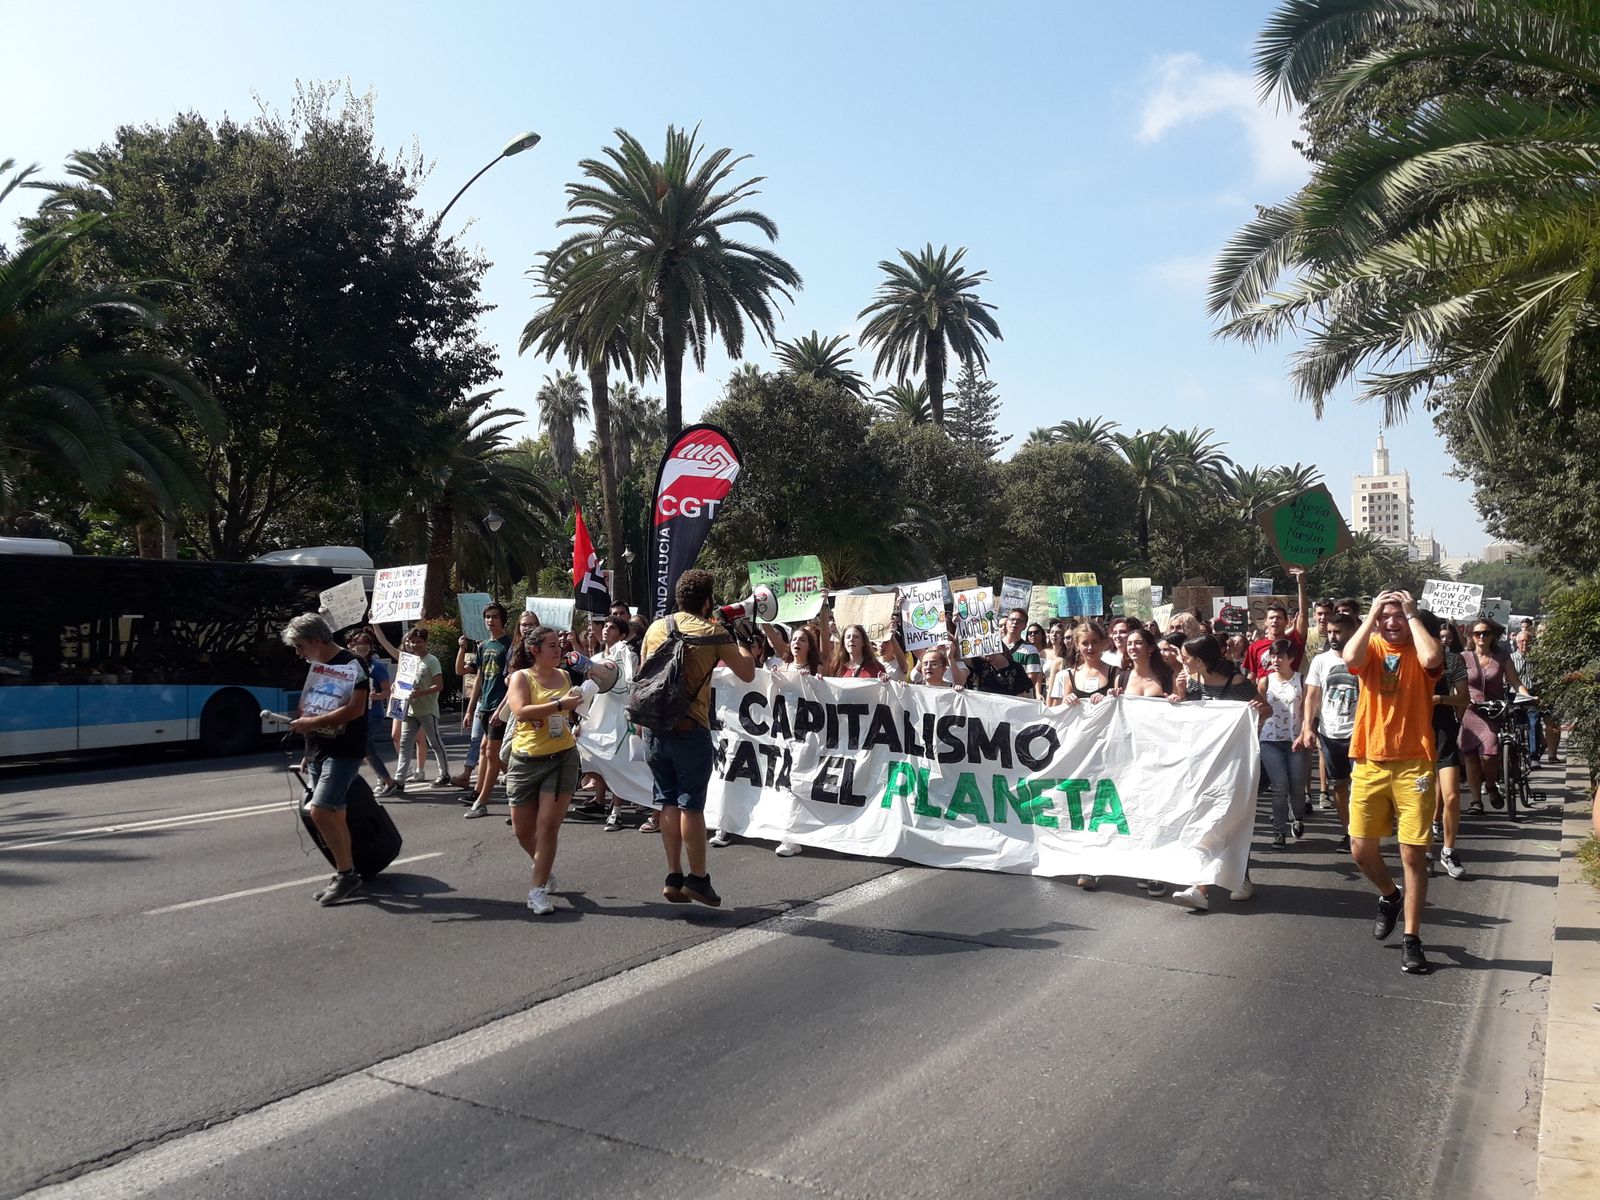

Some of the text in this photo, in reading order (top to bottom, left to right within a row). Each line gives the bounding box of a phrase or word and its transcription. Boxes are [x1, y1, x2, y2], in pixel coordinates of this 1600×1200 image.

[658, 495, 720, 520] CGT
[655, 527, 671, 620] ANDALUCÍA
[784, 575, 818, 593] HOTTER
[1436, 582, 1470, 593] FIGHT
[900, 586, 918, 599] WE
[1458, 594, 1471, 602] OR
[957, 592, 987, 620] OUR
[1431, 598, 1464, 608] CHOKE
[1430, 606, 1465, 616] LATER
[906, 631, 949, 644] HAVE TIME
[707, 687, 1061, 773] L CAPITALISMO
[810, 754, 868, 808] EL
[881, 760, 1132, 837] PLANETA
